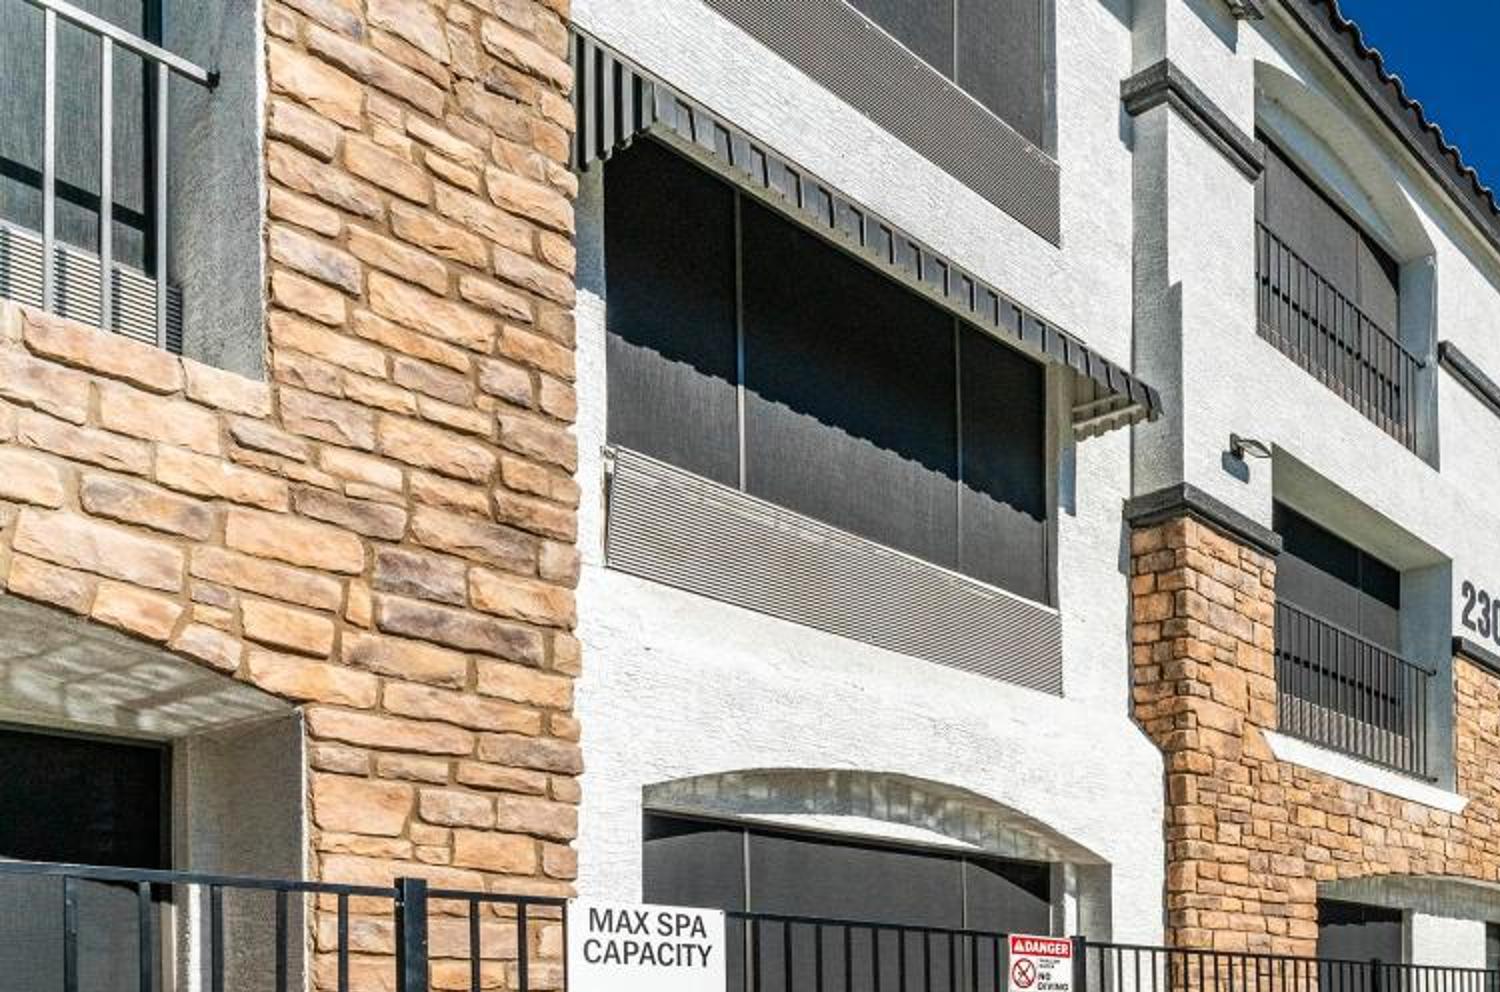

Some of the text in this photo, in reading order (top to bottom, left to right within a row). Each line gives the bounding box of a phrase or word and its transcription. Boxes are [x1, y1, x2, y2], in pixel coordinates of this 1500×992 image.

[589, 907, 707, 938] MAX SPA
[583, 938, 713, 968] CAPACITY
[1025, 940, 1069, 955] DANGER
[1038, 972, 1051, 981] NO
[1037, 982, 1069, 991] DIVING
